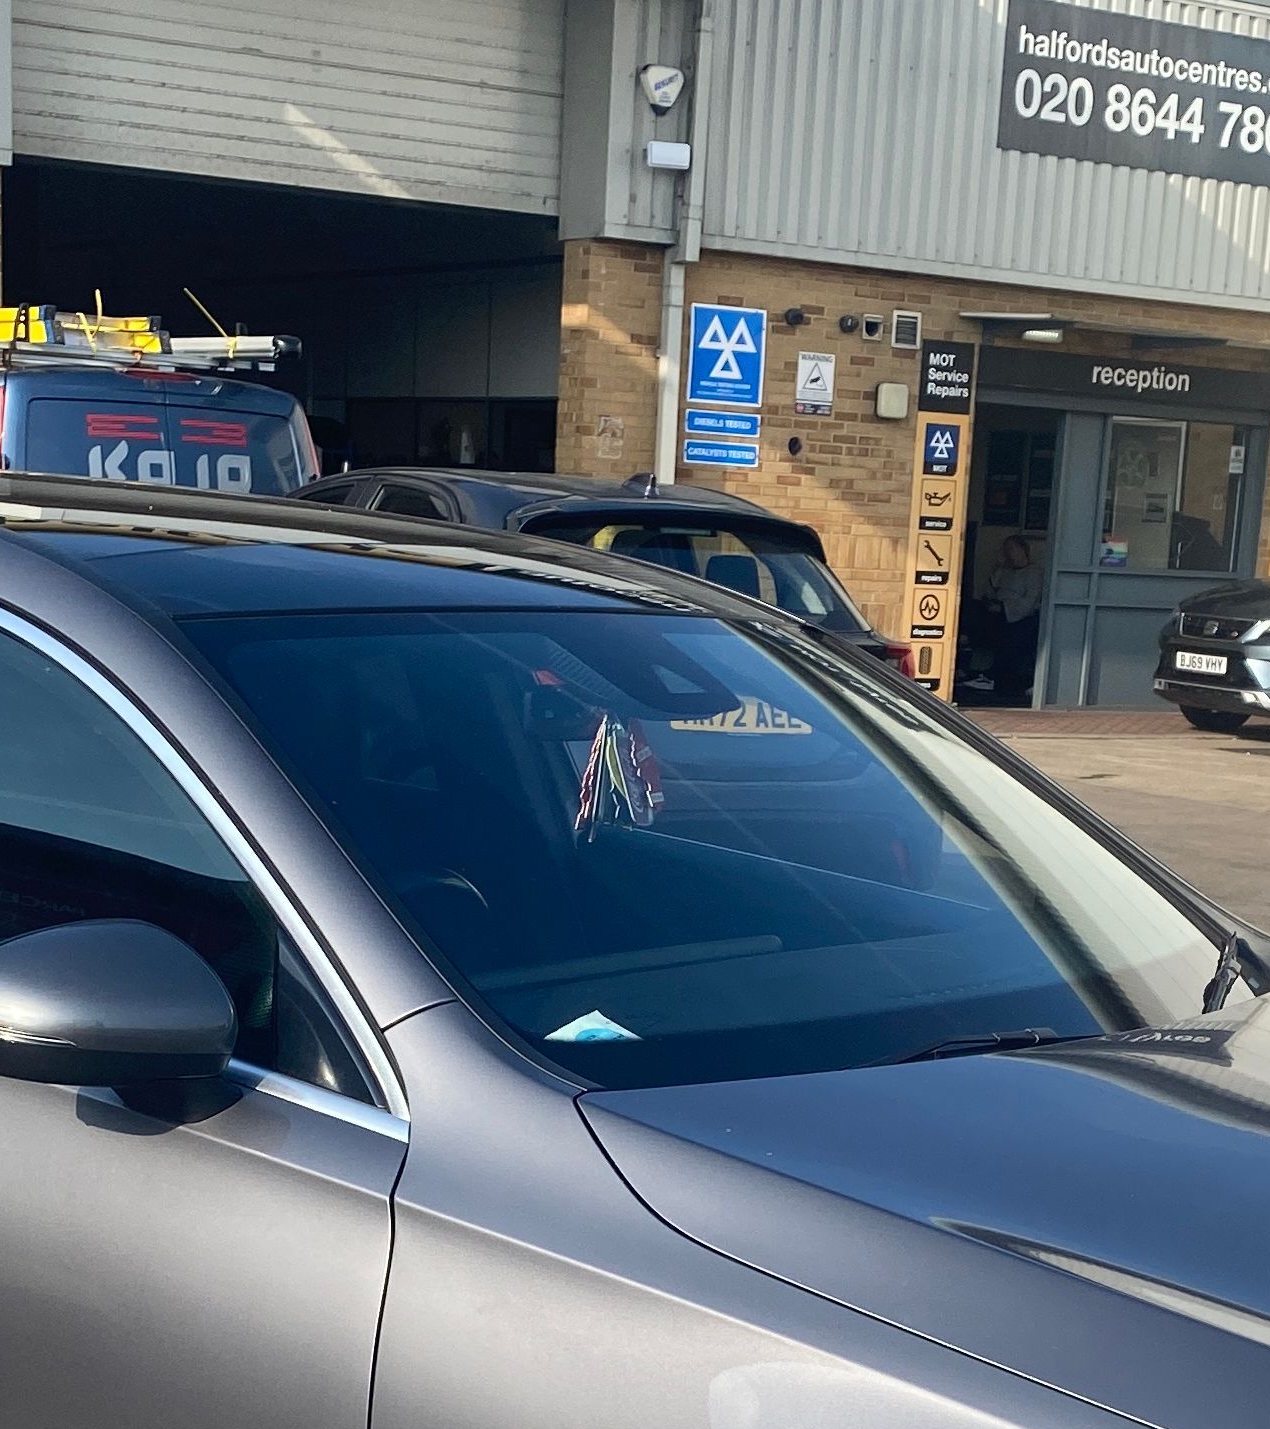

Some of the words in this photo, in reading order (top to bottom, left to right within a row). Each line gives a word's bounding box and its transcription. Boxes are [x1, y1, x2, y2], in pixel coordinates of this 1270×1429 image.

[1015, 68, 1094, 127] 020
[1104, 82, 1205, 144] 8644
[930, 353, 956, 367] MOT
[928, 367, 969, 383] Service
[1092, 365, 1190, 393] reception
[927, 382, 969, 398] Repairs
